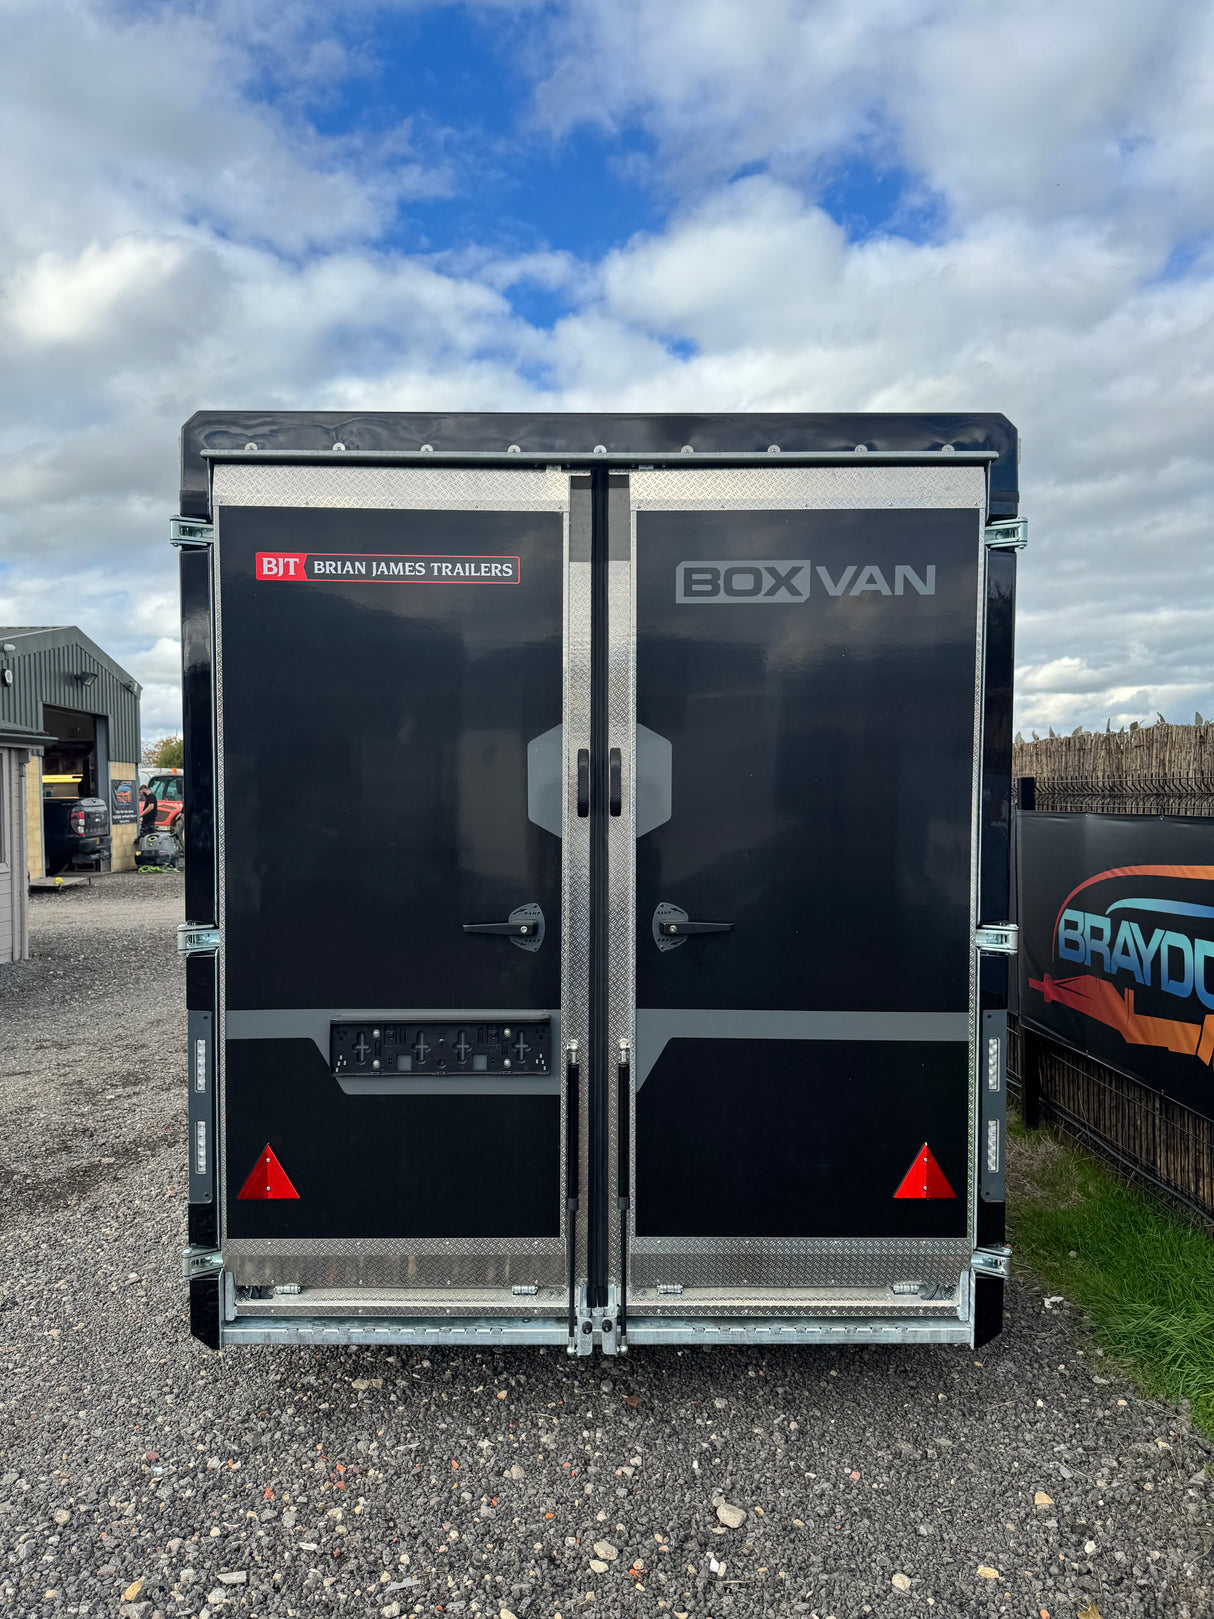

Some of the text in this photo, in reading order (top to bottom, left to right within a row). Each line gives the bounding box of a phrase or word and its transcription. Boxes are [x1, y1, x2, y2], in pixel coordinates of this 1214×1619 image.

[262, 557, 299, 577] BJT
[313, 560, 513, 577] BRIAN JAMES TRAILERS
[683, 564, 936, 597] BOX VAN
